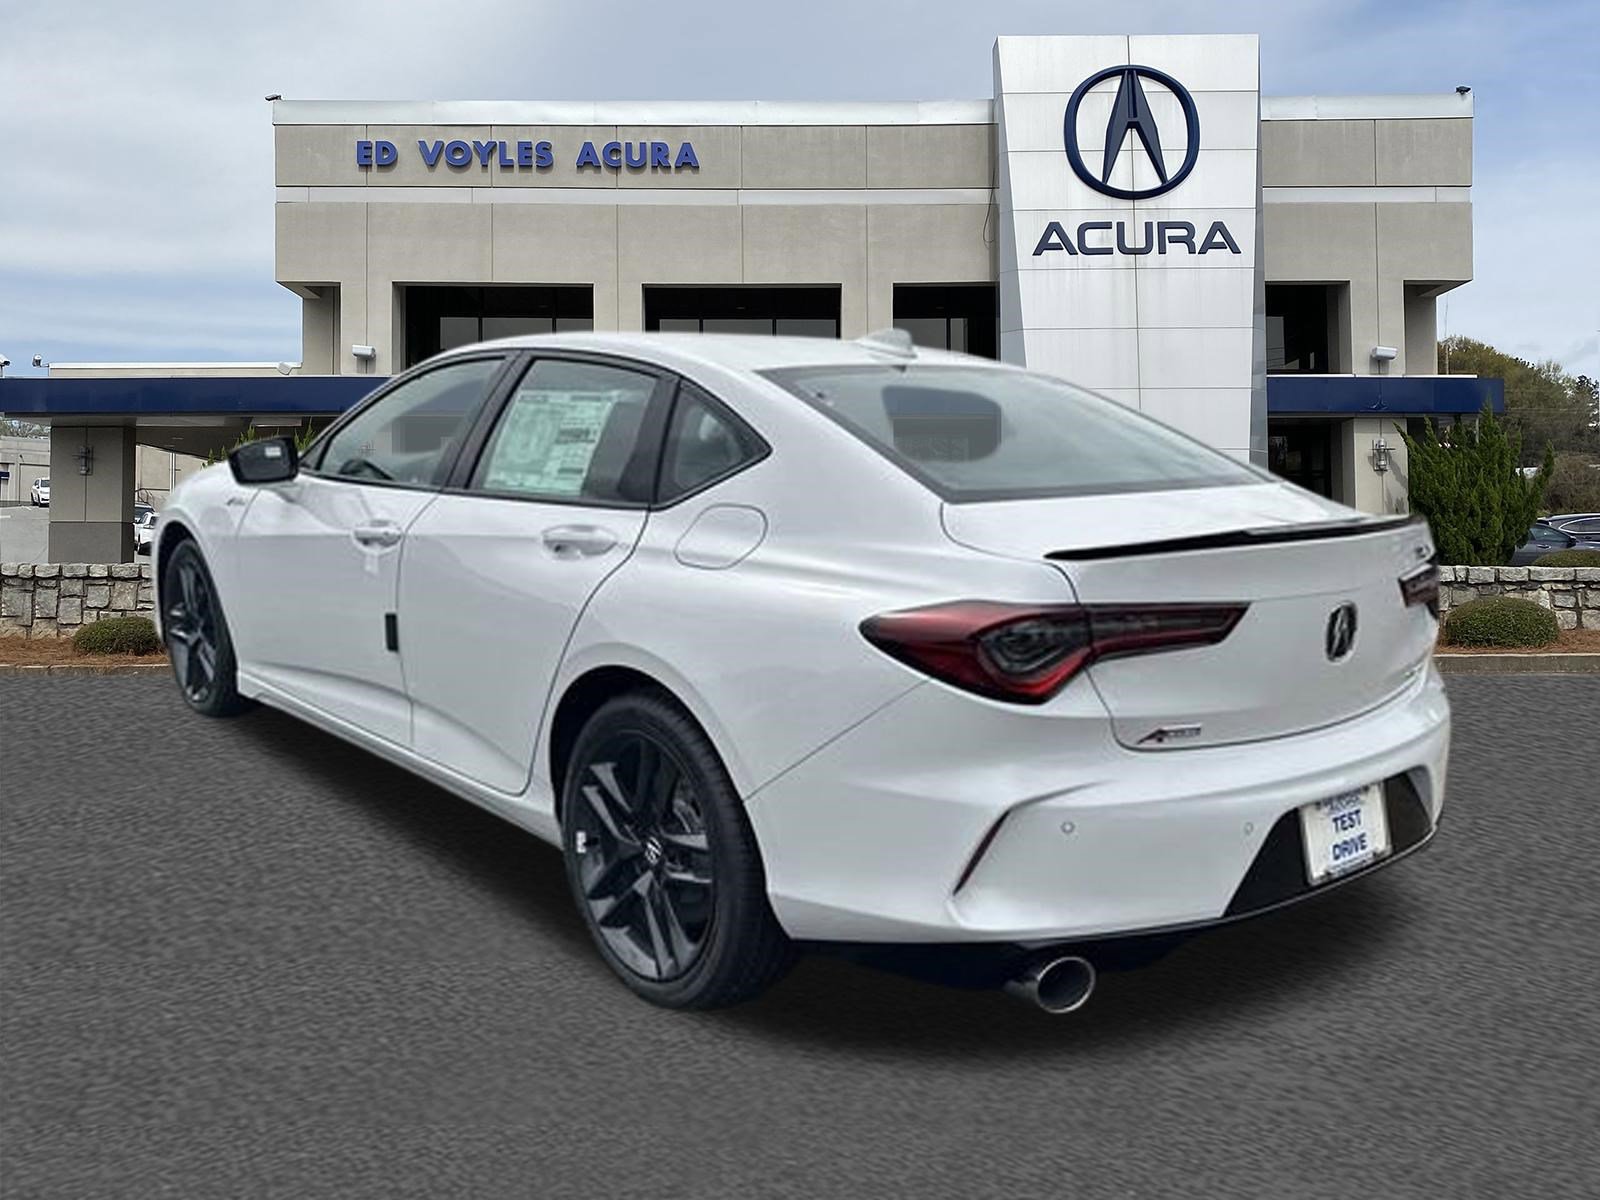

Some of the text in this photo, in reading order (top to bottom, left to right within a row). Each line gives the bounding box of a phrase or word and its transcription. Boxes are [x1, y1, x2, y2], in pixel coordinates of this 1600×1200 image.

[356, 140, 700, 168] ED VOYLES ACURA
[1032, 221, 1242, 256] ACURA
[1332, 809, 1361, 833] TEST
[1332, 833, 1367, 861] DRIVE
